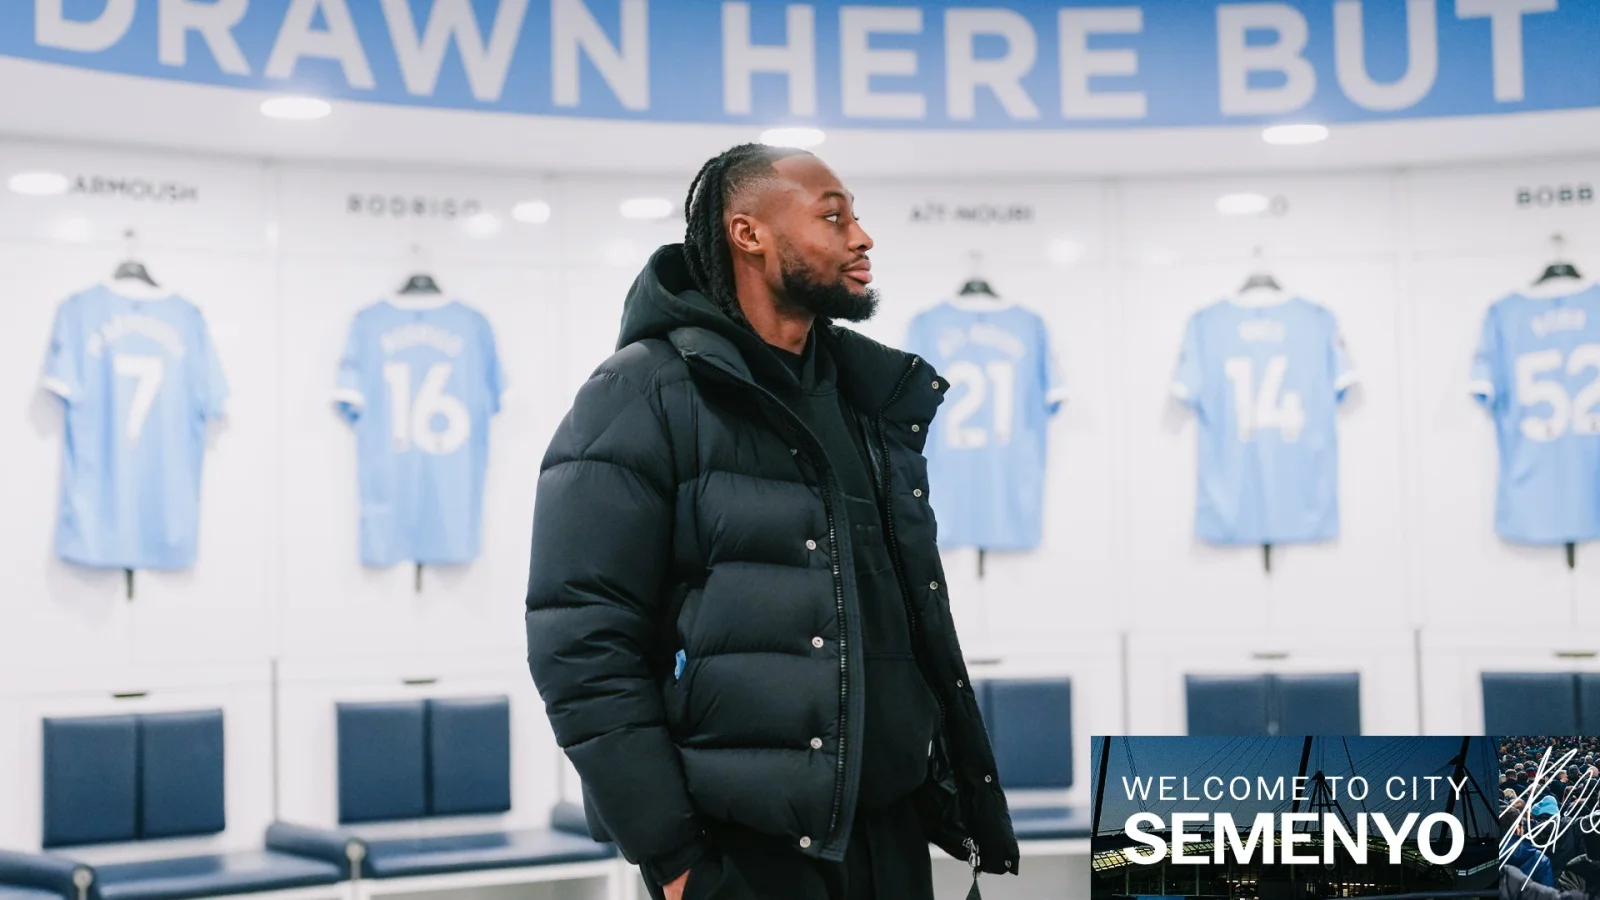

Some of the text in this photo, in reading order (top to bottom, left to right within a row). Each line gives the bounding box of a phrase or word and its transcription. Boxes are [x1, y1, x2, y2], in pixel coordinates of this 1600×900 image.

[723, 2, 1149, 121] HERE
[1216, 0, 1558, 117] BUT
[67, 174, 199, 203] ARMOUSH
[346, 193, 481, 220] RODRIGO
[1516, 183, 1594, 208] BOBB
[113, 354, 163, 444] 7
[383, 362, 470, 455] 16
[944, 361, 1014, 449] 21
[1224, 356, 1304, 442] 14
[1515, 343, 1600, 441] 52
